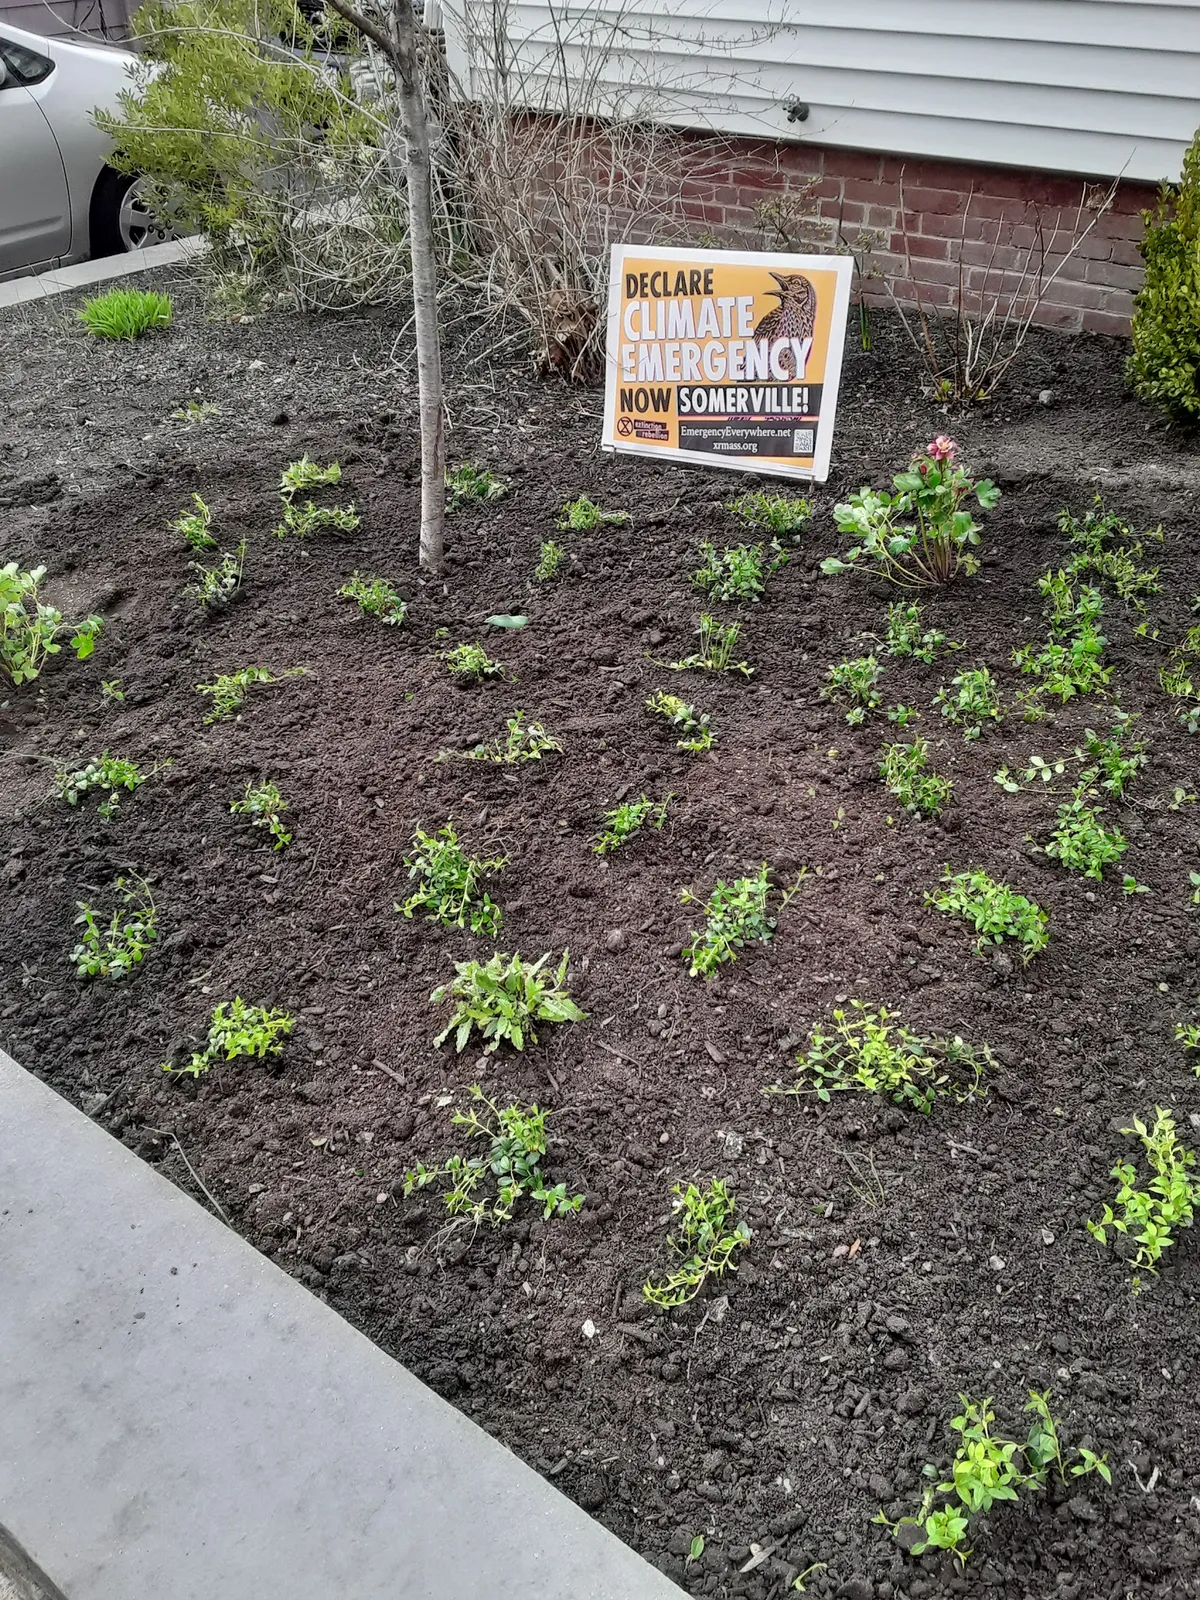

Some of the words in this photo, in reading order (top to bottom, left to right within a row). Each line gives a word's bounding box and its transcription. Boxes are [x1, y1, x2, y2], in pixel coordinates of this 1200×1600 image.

[626, 269, 714, 299] DECLARE
[624, 296, 754, 341] CLIMATE
[622, 337, 813, 382] EMERGENCY
[620, 388, 671, 413] NOW
[680, 387, 809, 413] SOMERVILLE!
[641, 430, 668, 440] rebellion
[680, 426, 791, 439] EmergencyEverywhere.net
[713, 441, 758, 453] xrmass.org
